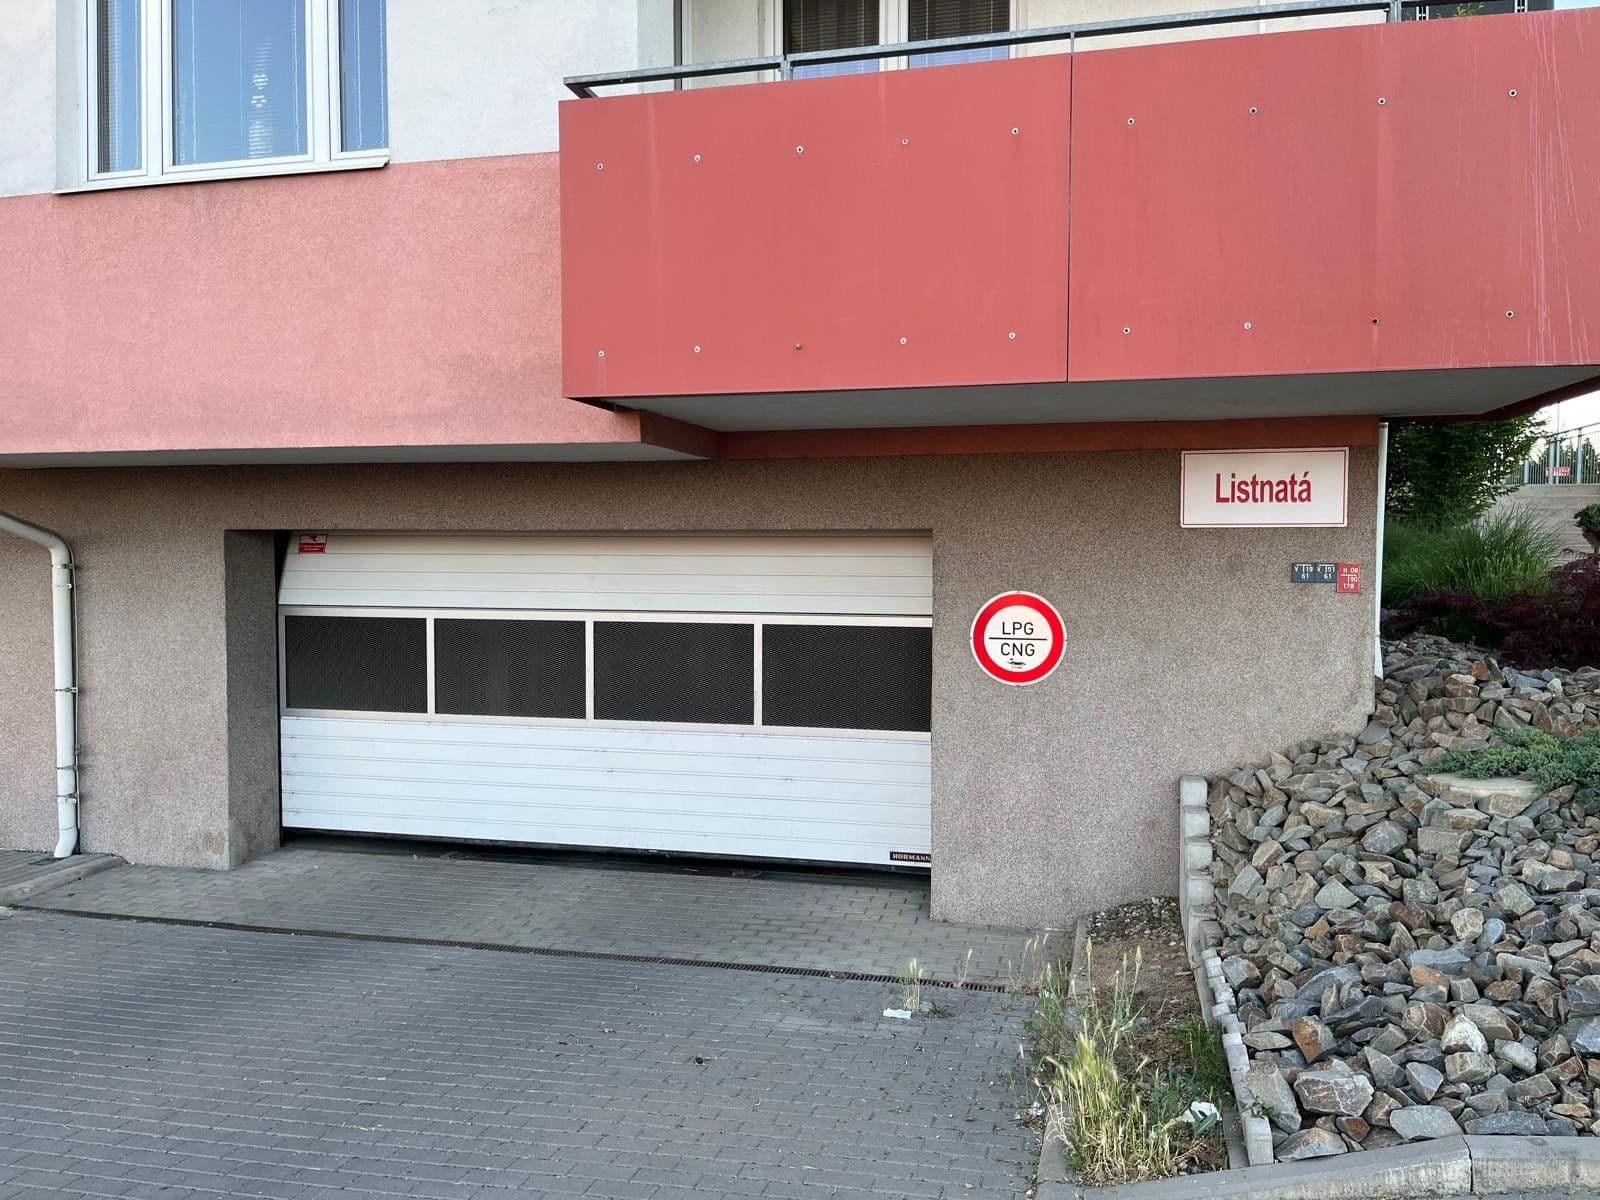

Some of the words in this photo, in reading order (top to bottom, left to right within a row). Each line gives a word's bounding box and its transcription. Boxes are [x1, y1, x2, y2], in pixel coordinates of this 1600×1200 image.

[1215, 471, 1312, 503] Listnatá
[1002, 621, 1034, 635] LPG
[1000, 643, 1035, 656] CNG
